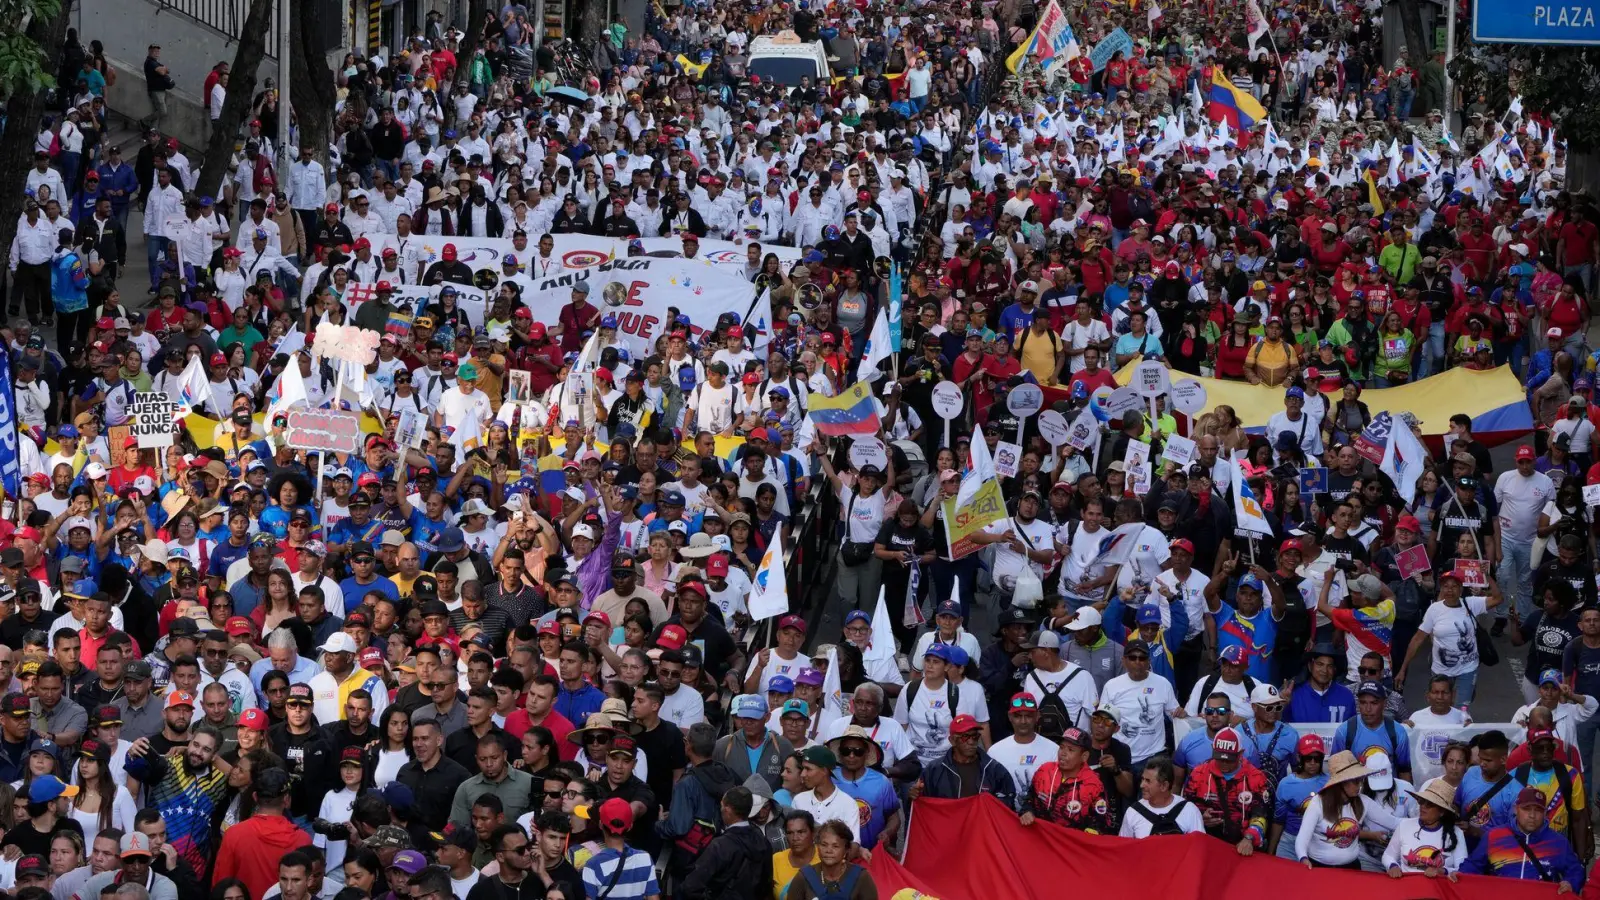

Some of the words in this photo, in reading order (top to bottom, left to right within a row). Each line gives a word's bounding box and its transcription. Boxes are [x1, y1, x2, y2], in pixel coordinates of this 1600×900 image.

[1535, 6, 1595, 27] PLAZA
[135, 392, 169, 404] MAS
[123, 402, 180, 416] FUERTE
[140, 413, 171, 425] QUE
[129, 423, 180, 436] NUNCA
[1215, 740, 1237, 751] FUTPV
